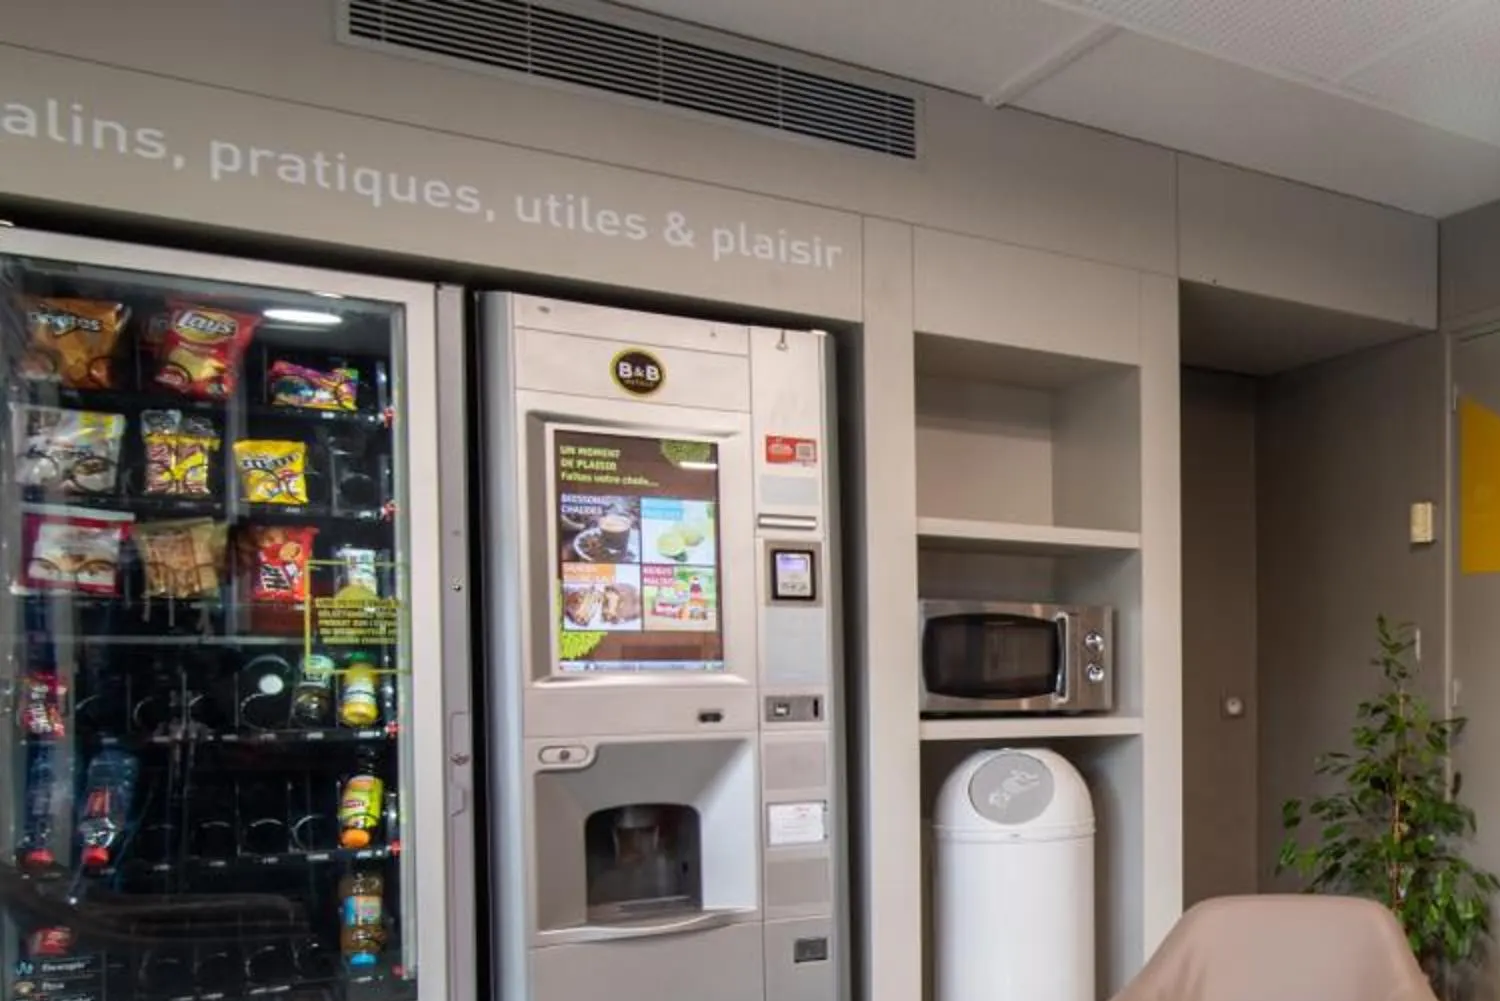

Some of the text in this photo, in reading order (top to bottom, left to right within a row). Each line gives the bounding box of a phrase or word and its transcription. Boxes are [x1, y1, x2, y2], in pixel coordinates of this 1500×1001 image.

[209, 139, 496, 223] pratiques,
[514, 194, 648, 241] utiles
[663, 211, 695, 247] &
[711, 221, 843, 270] plaisir
